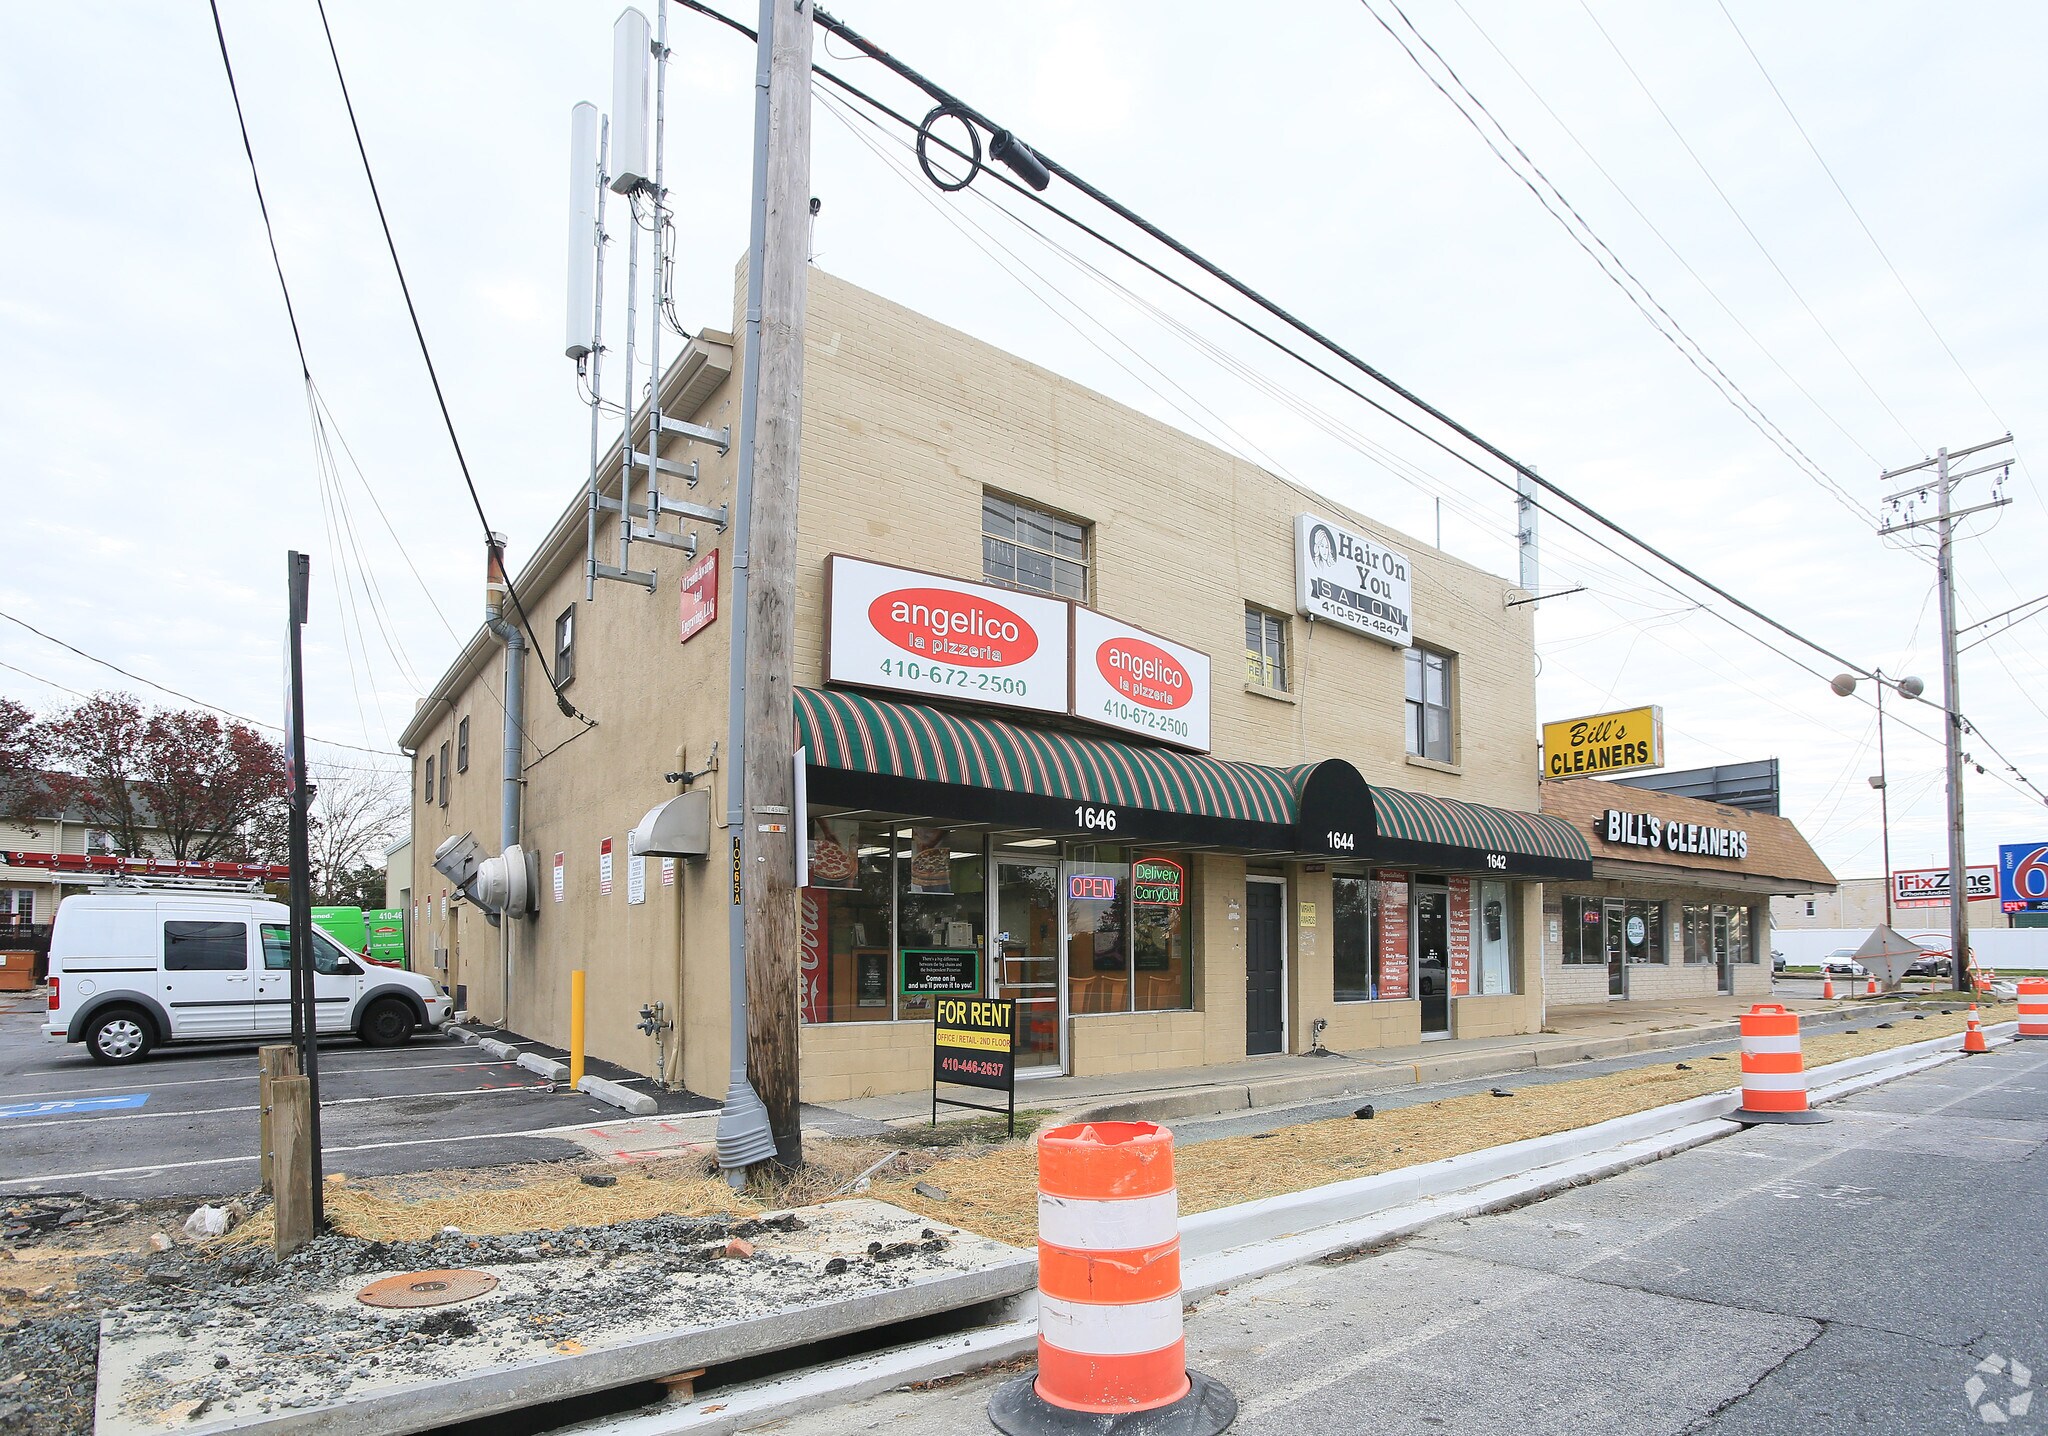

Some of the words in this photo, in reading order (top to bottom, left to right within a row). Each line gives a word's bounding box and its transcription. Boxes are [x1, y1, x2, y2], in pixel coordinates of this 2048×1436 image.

[1338, 532, 1380, 570] Hair
[1382, 552, 1407, 582] On
[1356, 565, 1392, 600] You
[1321, 581, 1400, 623] SALON
[890, 600, 1019, 642] angelico
[908, 632, 925, 650] la
[932, 636, 1003, 662] pizzeria
[879, 658, 1027, 697] 410-672-2500
[1108, 646, 1183, 689] angelico
[1119, 675, 1130, 692] la
[1133, 680, 1174, 705] pizzeria
[1103, 698, 1189, 738] 410-672-2500
[1569, 718, 1628, 747] Bill's
[1551, 741, 1649, 775] CLEANERS
[1074, 805, 1117, 831] 1646
[1326, 830, 1355, 851] 1644
[1607, 809, 1662, 848] BILL'S
[1666, 820, 1748, 859] CLEANERS
[1136, 864, 1179, 885] Delivery
[1486, 853, 1507, 870] 1642
[2012, 846, 2048, 899] 6
[1072, 877, 1114, 898] OPEN
[1135, 885, 1179, 903] CarryOut
[1898, 873, 1991, 890] iFixZne
[933, 982, 948, 990] prove
[961, 982, 972, 990] you!
[937, 1000, 967, 1025] FOR
[971, 1002, 1011, 1028] RENT
[937, 1033, 956, 1043] OFFICE
[980, 1036, 991, 1046] 2ND
[992, 1037, 1011, 1048] FLOOR
[942, 1057, 1003, 1077] 410-446-2637
